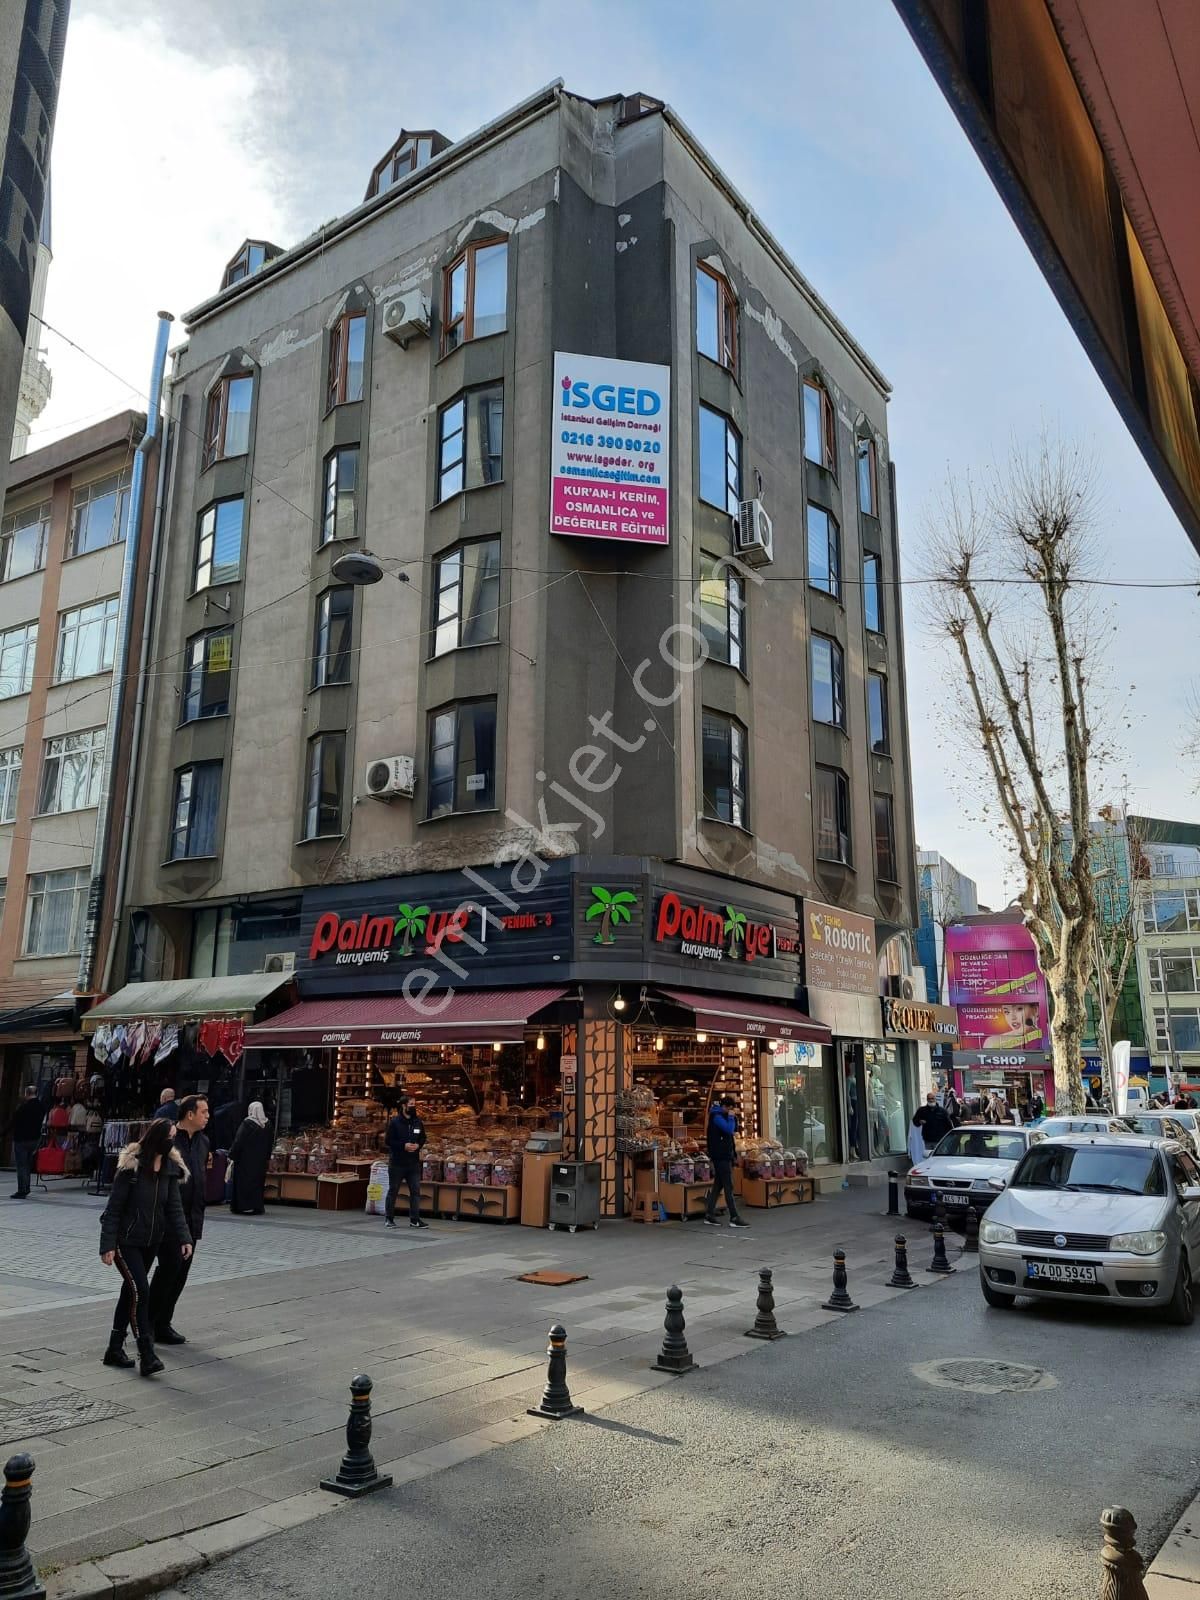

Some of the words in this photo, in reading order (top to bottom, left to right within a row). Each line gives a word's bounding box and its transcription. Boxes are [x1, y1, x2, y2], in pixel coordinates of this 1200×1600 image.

[561, 430, 594, 446] 0216
[565, 501, 638, 518] OSMANLICA
[641, 511, 655, 519] ve
[555, 515, 618, 531] DEĞERLER
[545, 912, 552, 928] 3
[335, 949, 389, 966] kuruyemiş
[681, 941, 722, 961] kuruyemiş
[321, 1031, 352, 1043] palmiye
[380, 1028, 422, 1042] kuruyemiş
[1033, 1263, 1047, 1276] 34
[1048, 1265, 1062, 1277] DD
[1064, 1266, 1093, 1280] 5945
